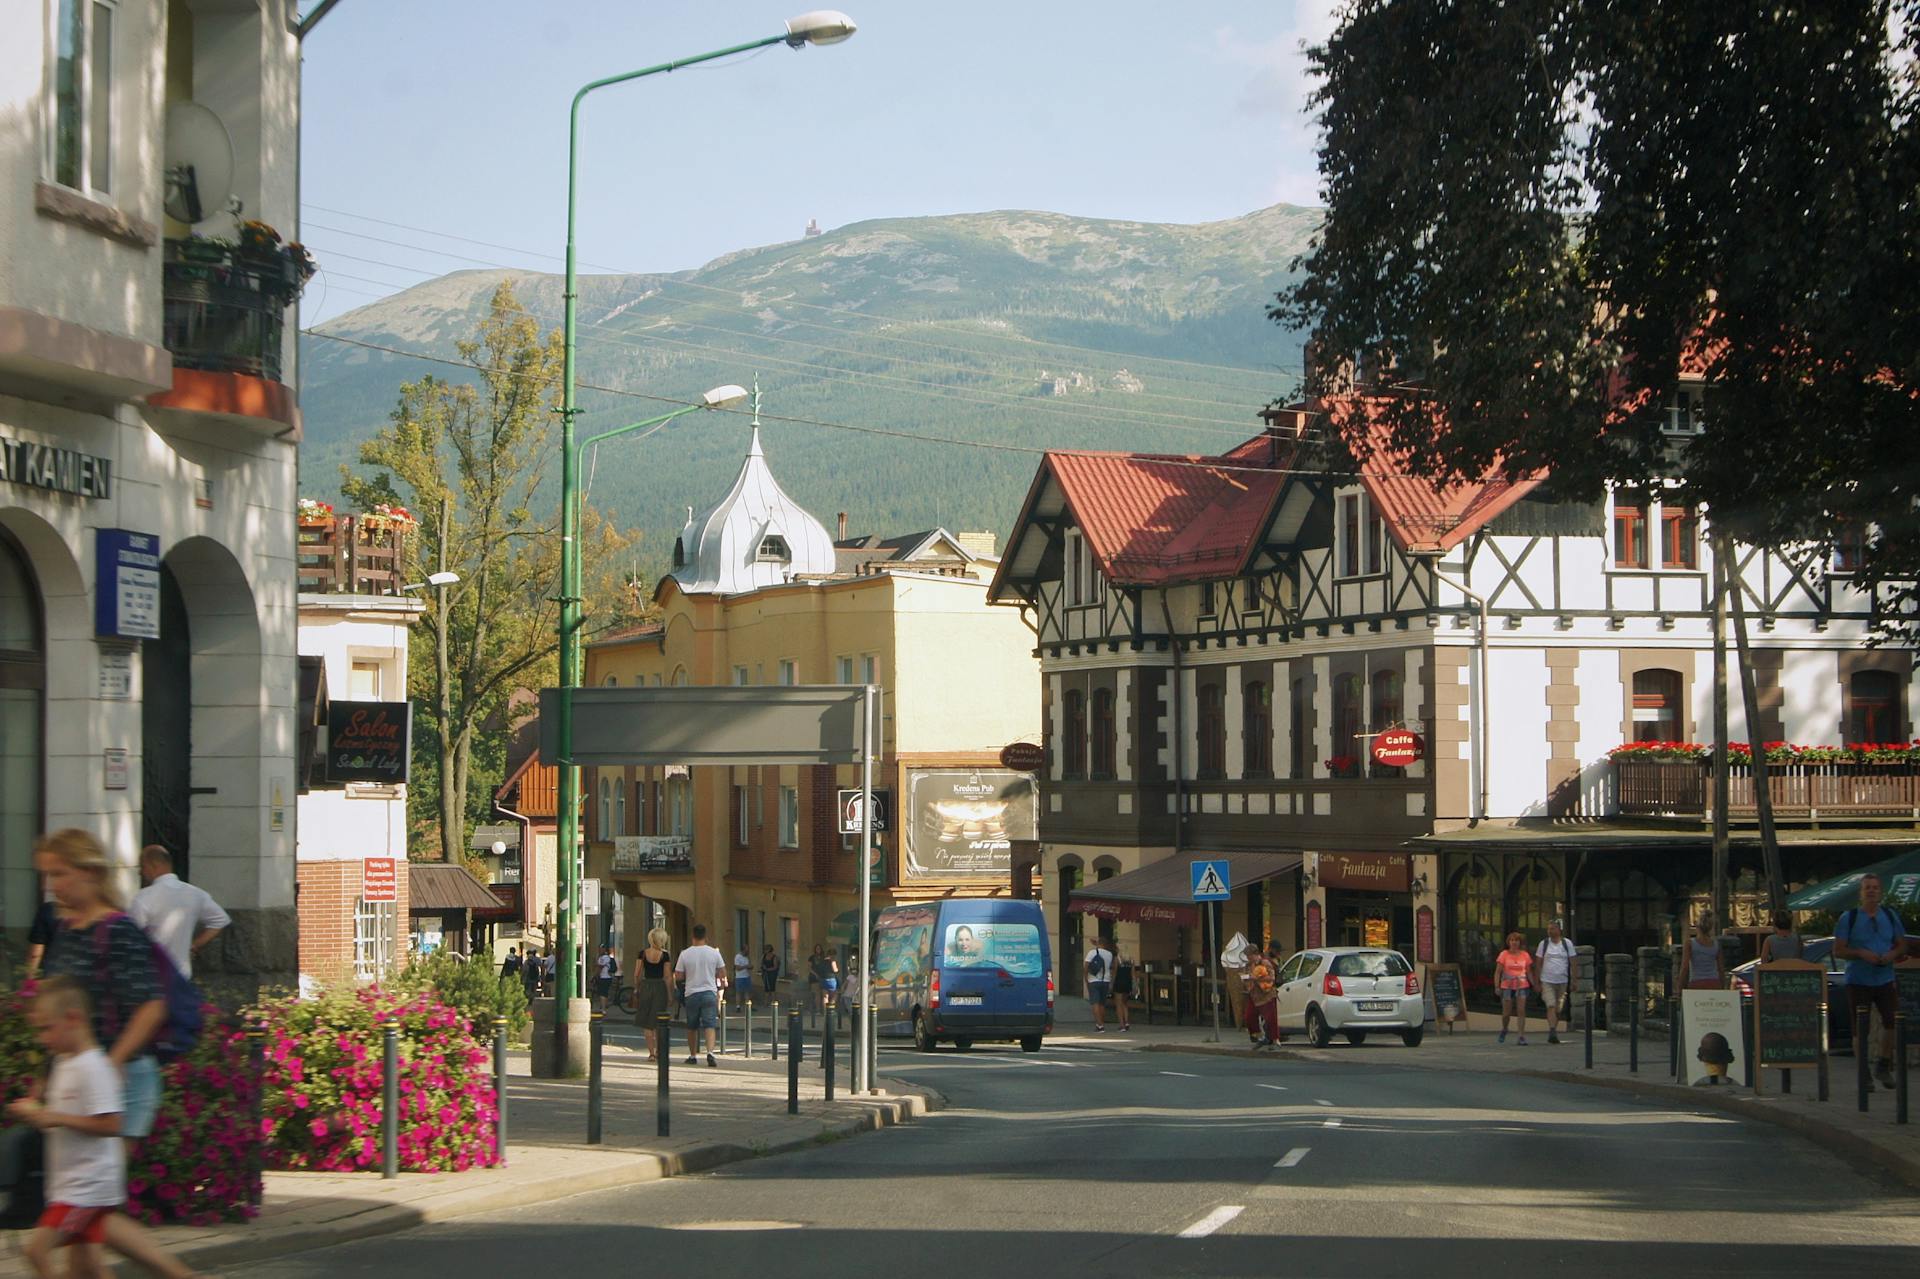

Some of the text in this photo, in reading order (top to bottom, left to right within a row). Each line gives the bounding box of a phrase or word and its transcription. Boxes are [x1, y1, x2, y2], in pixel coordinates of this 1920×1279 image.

[26, 442, 112, 499] KAMIENI
[344, 709, 400, 737] Salon
[1385, 735, 1414, 745] Caffe
[378, 753, 401, 775] Lady
[1375, 747, 1422, 759] Fantazja
[953, 784, 995, 793] Kredens Pub
[1340, 857, 1387, 881] Fantazja
